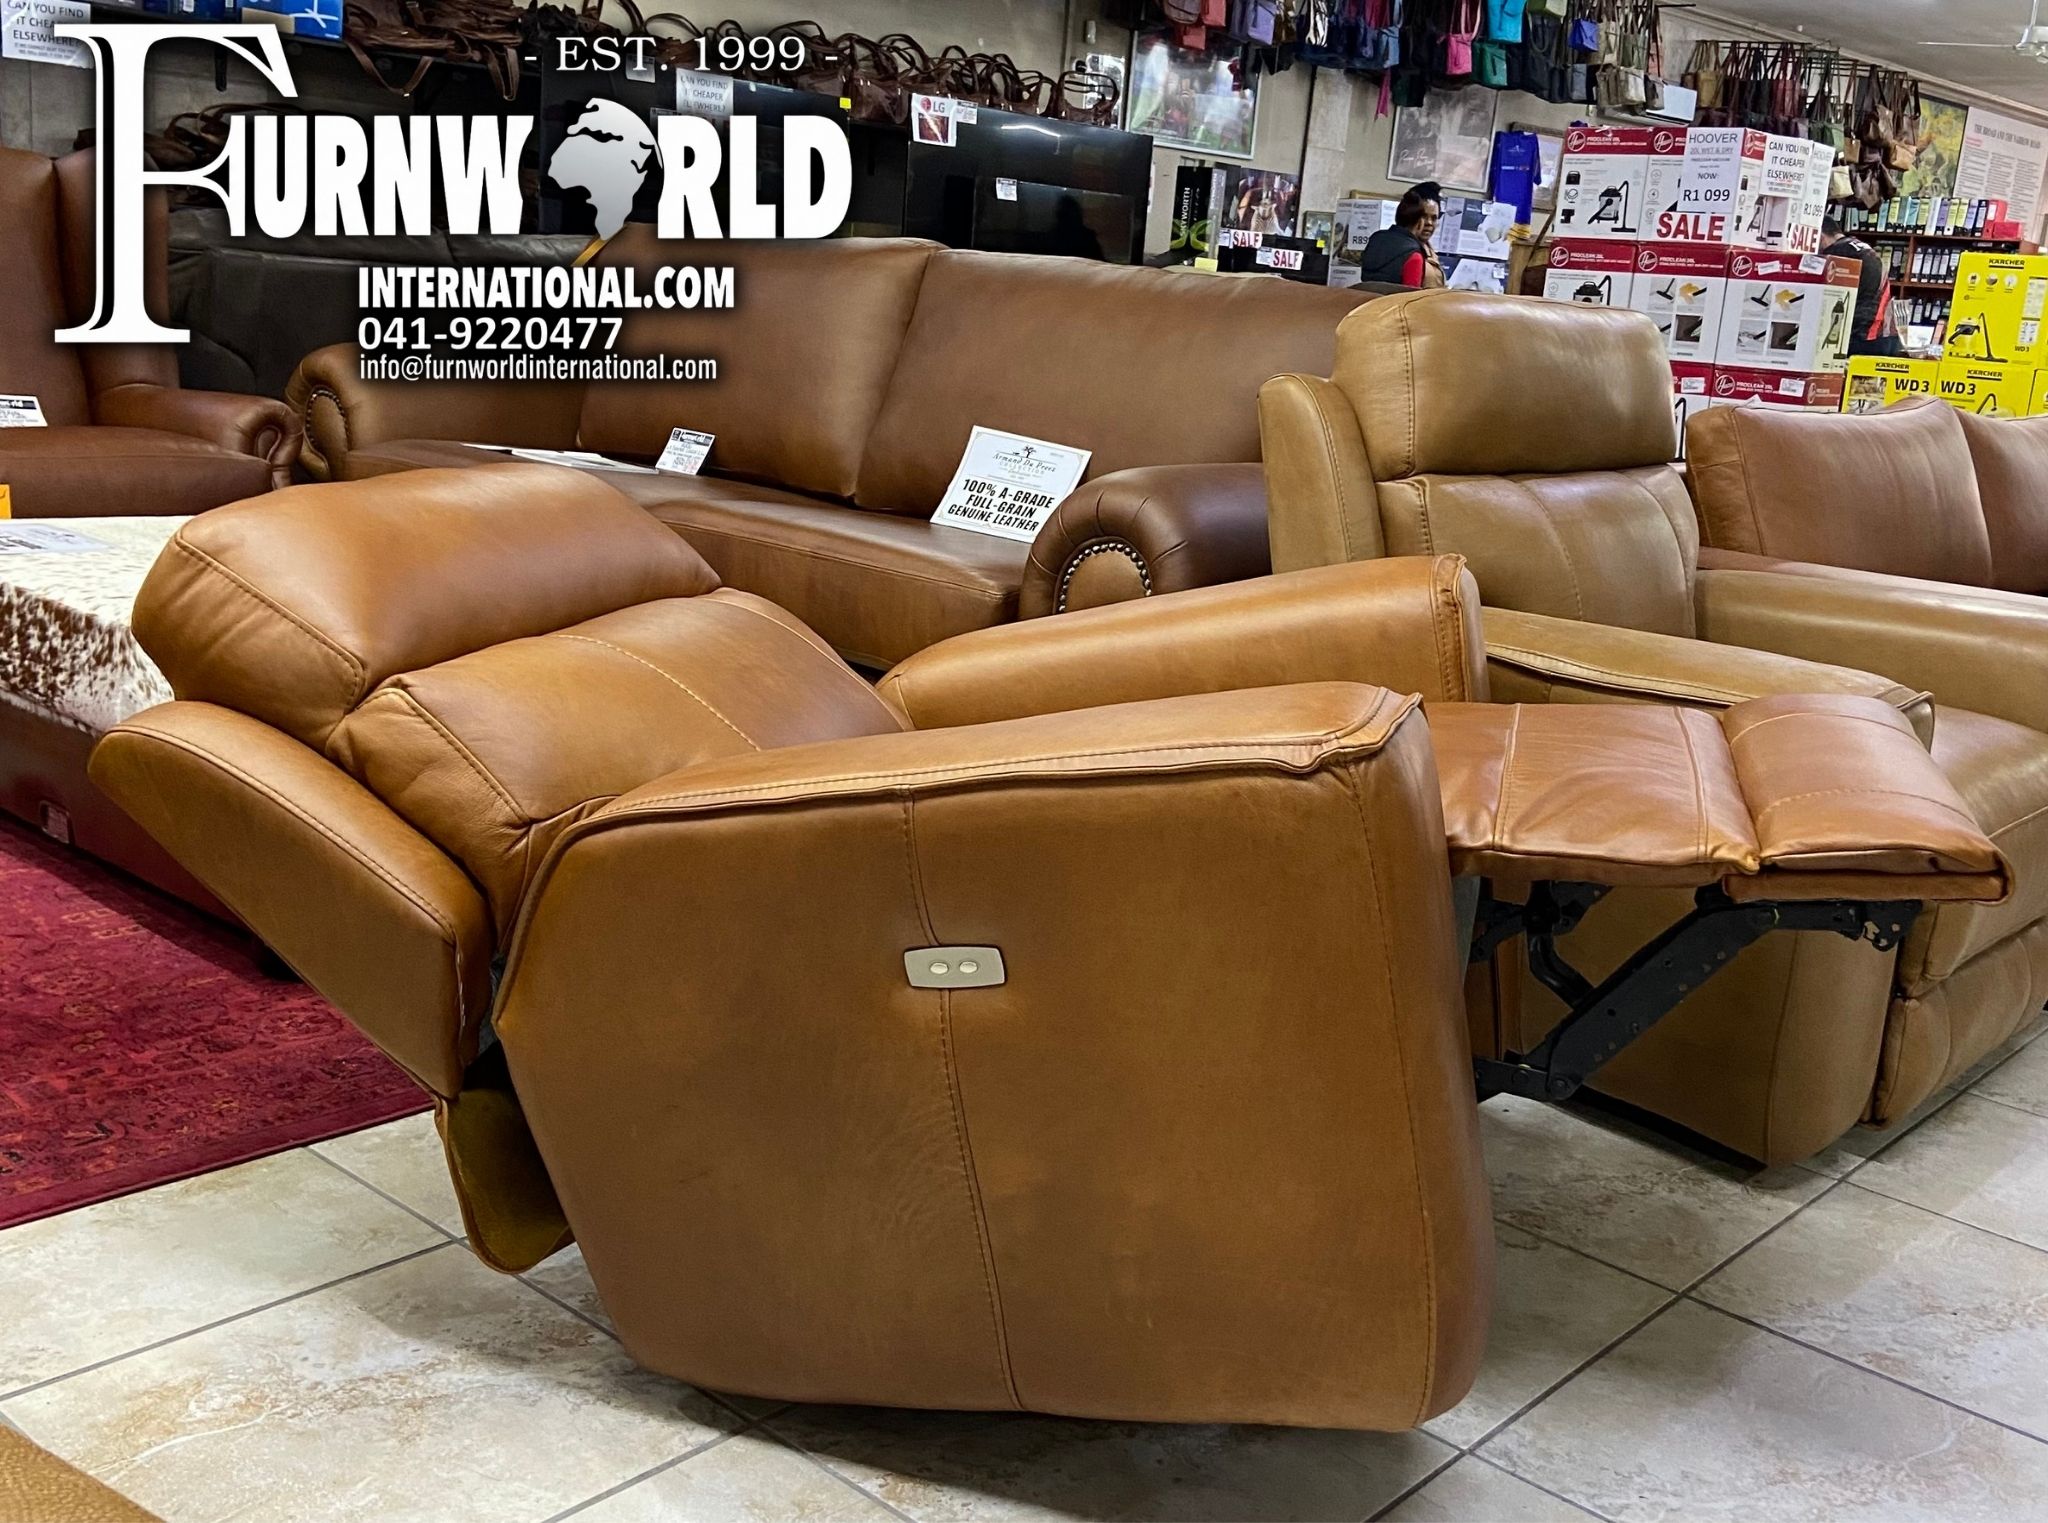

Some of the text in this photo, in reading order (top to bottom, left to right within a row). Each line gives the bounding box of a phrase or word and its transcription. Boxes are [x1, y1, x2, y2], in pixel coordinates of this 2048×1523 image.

[34, 4, 55, 14] YOU
[60, 7, 84, 18] FIND
[697, 78, 711, 87] YOU
[712, 81, 729, 90] FIND
[693, 89, 724, 101] CHEAPER
[933, 101, 945, 113] LG
[1689, 133, 1738, 143] HOOVER
[1769, 141, 1783, 151] CAN
[1785, 143, 1799, 153] YOU
[1771, 156, 1805, 168] IT CHEAPER
[1683, 189, 1730, 201] R1 099
[1656, 212, 1726, 242] SALE
[1352, 235, 1370, 245] R89
[1791, 224, 1819, 253] SALE
[1895, 378, 1930, 392] WD 3
[1941, 381, 1976, 395] WD 3
[962, 478, 997, 497] 100%
[999, 487, 1055, 509] A-GRADE
[965, 494, 1037, 519] FULL-GRAIN
[948, 504, 1039, 532] GENUINE LEATHER
